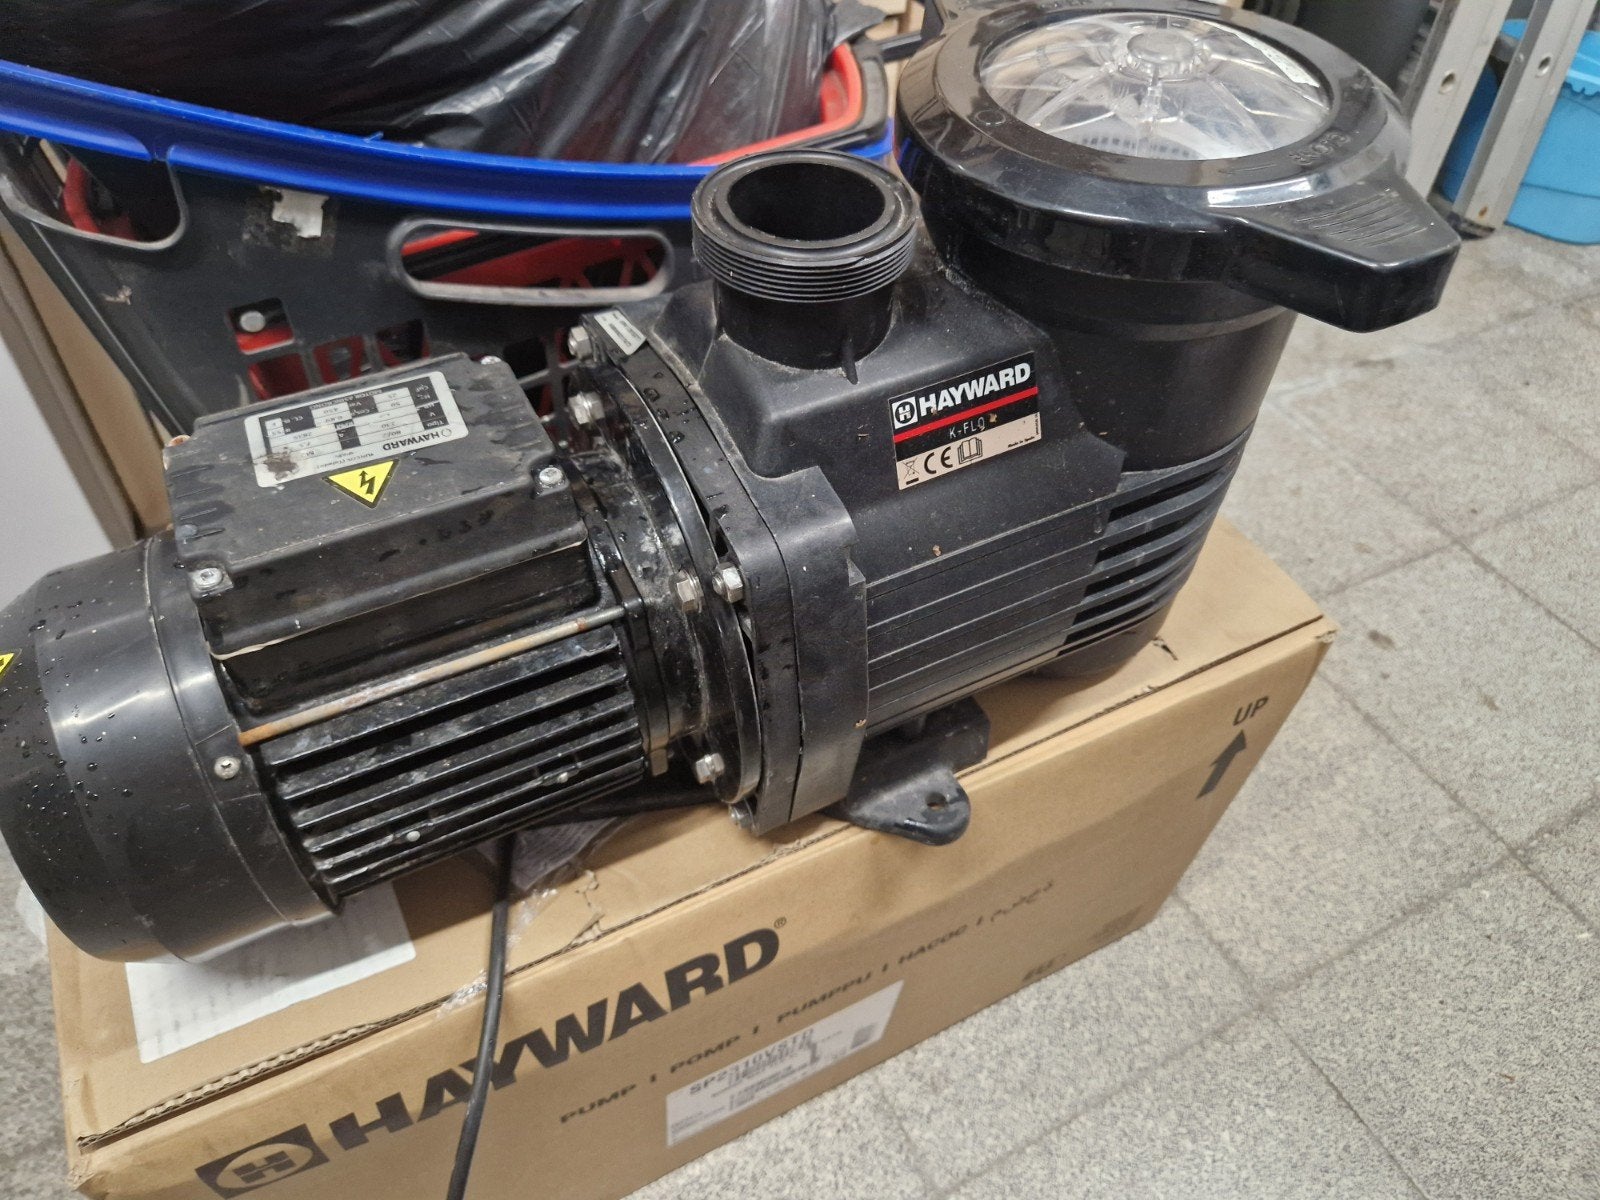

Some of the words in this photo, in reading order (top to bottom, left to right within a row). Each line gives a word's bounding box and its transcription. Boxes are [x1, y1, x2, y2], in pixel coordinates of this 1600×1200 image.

[919, 362, 1031, 417] HAYWARD
[382, 431, 440, 451] HAYWARD
[949, 416, 985, 439] K-FLO
[1233, 696, 1269, 726] UP
[560, 1084, 637, 1123] PUMP
[670, 1034, 741, 1073] POMP
[777, 970, 872, 1023] PUMPPU
